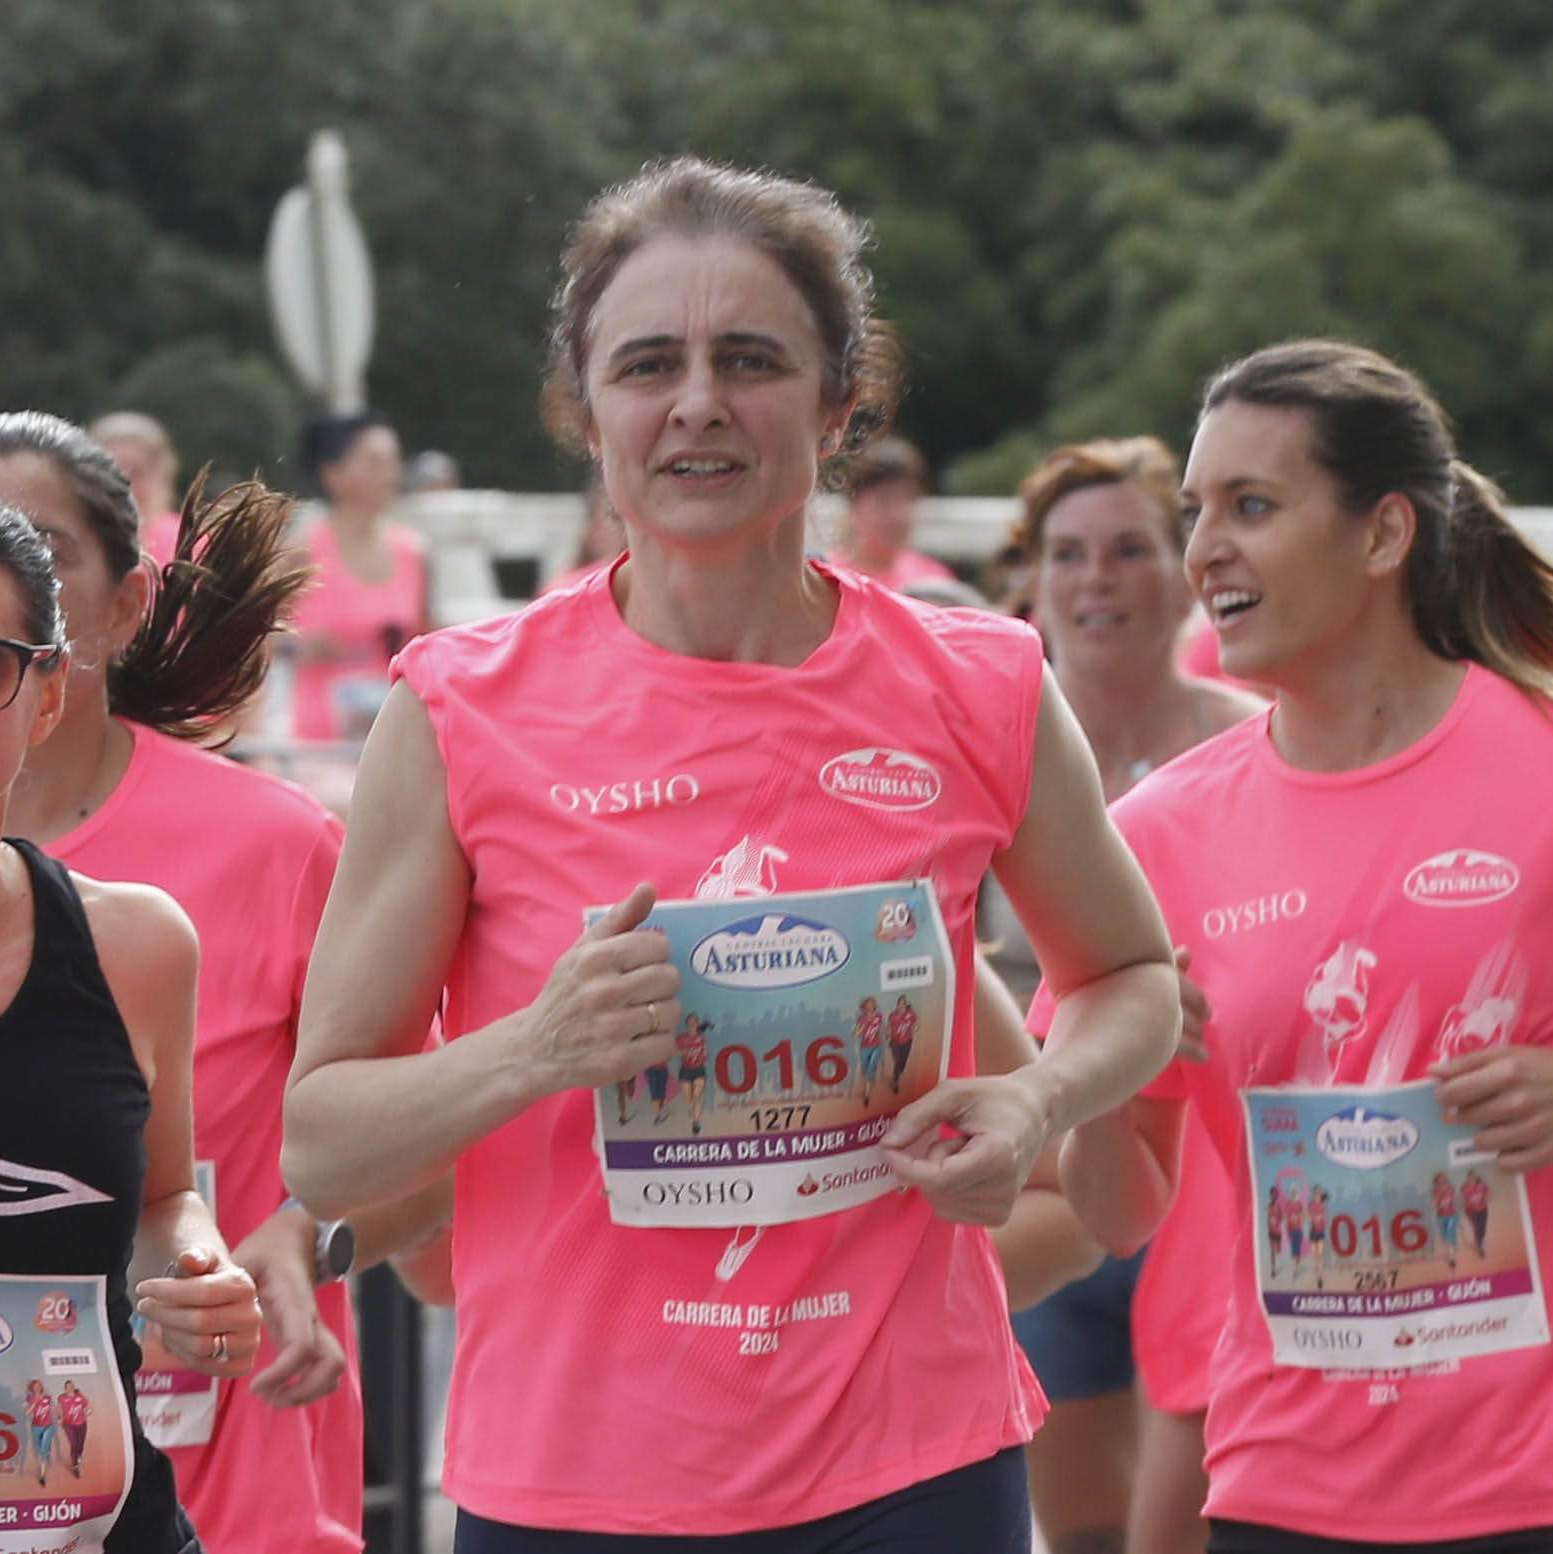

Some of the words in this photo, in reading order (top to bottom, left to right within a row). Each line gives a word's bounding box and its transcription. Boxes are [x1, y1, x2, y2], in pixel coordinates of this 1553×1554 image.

[549, 773, 700, 815] OYSHO
[831, 765, 933, 799] ASTURIANA
[1413, 872, 1511, 897] ASTURIANA
[880, 903, 910, 930] 20
[1202, 888, 1307, 940] OYSHO
[701, 946, 840, 977] ASTURIANA
[714, 1035, 849, 1094] 016
[749, 1105, 812, 1132] 1277
[652, 1141, 732, 1164] CARRERA
[736, 1139, 761, 1160] DE
[763, 1137, 788, 1158] LA
[791, 1130, 846, 1154] MUJER
[1322, 1129, 1411, 1154] ASTURIANA
[642, 1178, 755, 1207] OYSHO
[1330, 1209, 1429, 1258] 016
[40, 1297, 73, 1321] 20
[662, 1299, 743, 1329] CARRERA
[746, 1304, 771, 1329] DE
[773, 1303, 790, 1328] LA
[791, 1291, 851, 1322] MUJER
[1292, 1294, 1345, 1313] CARRERA
[1347, 1295, 1365, 1313] DE
[1366, 1295, 1384, 1312] LA
[1384, 1287, 1435, 1312] MUJER
[738, 1330, 780, 1356] 2024
[1293, 1327, 1363, 1351] OYSHO
[1415, 1317, 1509, 1344] Santander
[32, 1498, 82, 1523] GIJÓN
